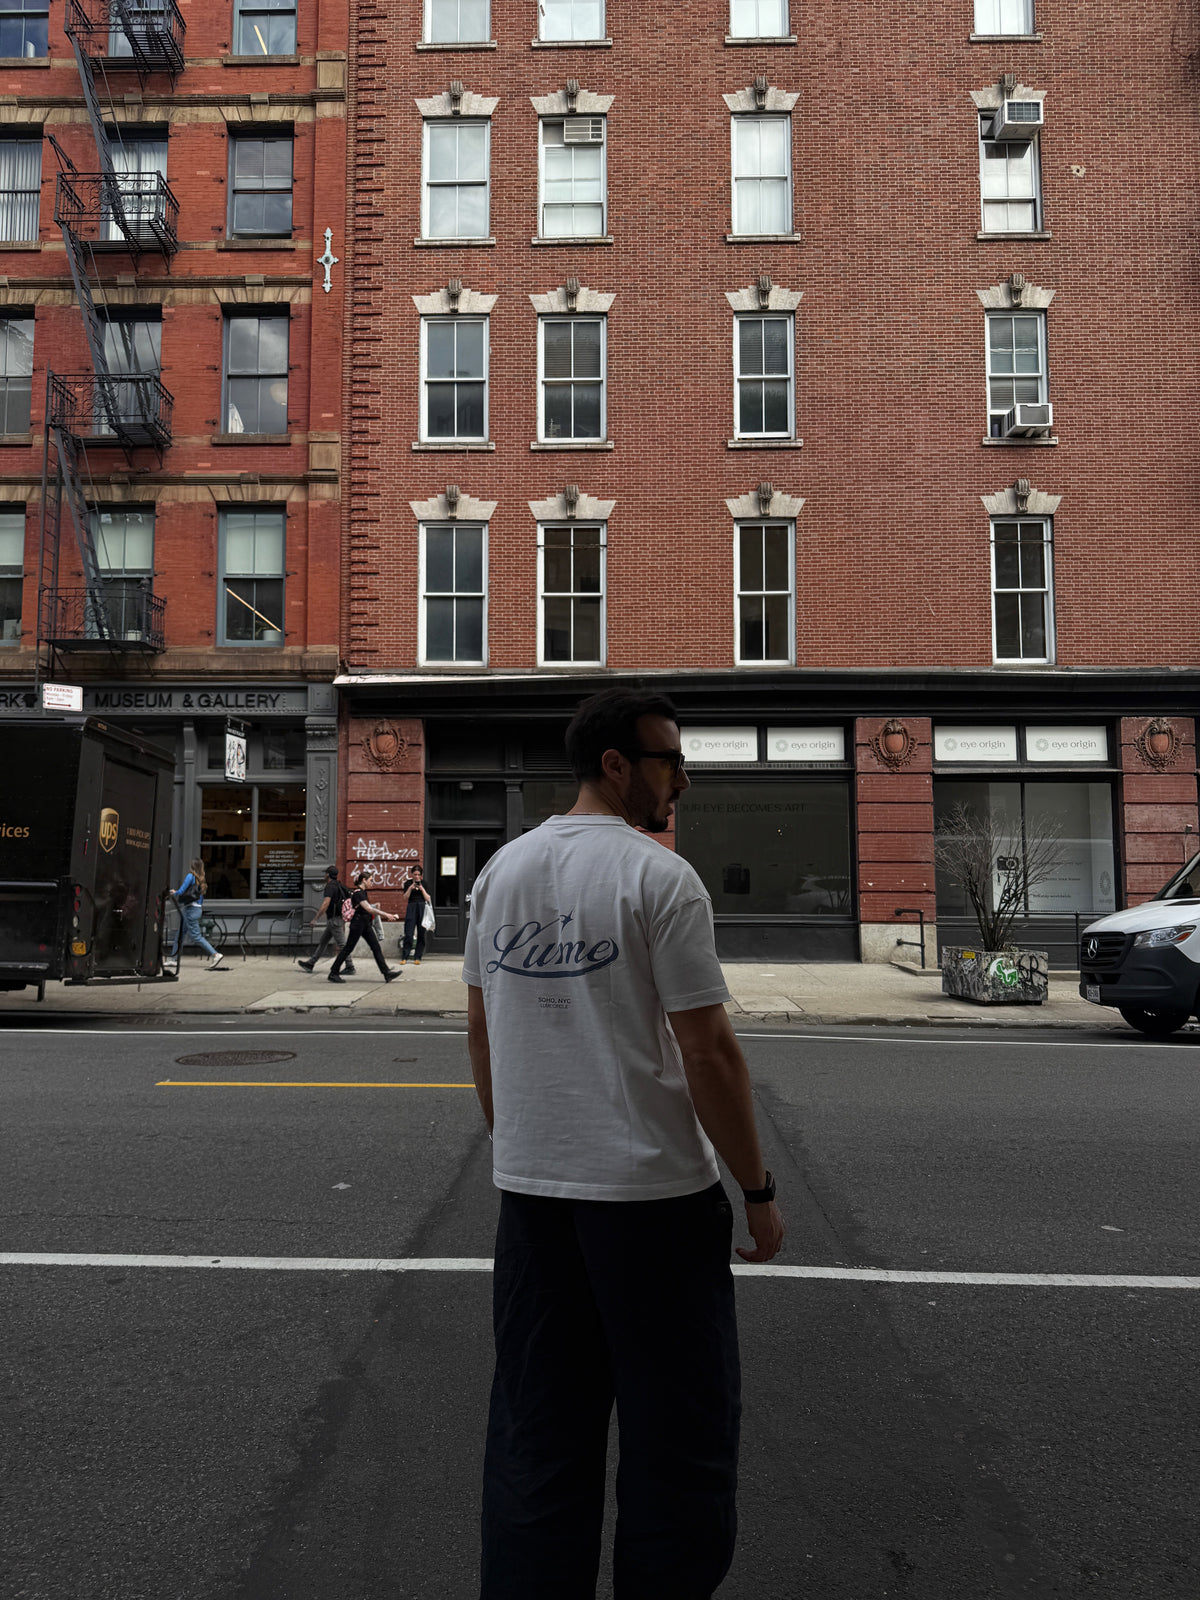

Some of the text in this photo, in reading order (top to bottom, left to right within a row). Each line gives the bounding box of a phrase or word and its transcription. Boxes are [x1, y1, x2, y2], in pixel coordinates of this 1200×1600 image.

[96, 693, 172, 708] MUSEUM
[182, 693, 194, 708] &
[198, 693, 281, 708] GALLERY
[704, 739, 749, 750] eye origin
[791, 740, 836, 751] eye origin
[960, 739, 1006, 749] eye origin
[1052, 739, 1097, 749] eye origin
[703, 803, 725, 813] EYE
[727, 803, 781, 813] BECOMES
[784, 803, 805, 813] ART
[0, 823, 30, 838] ices
[101, 821, 118, 846] ups
[486, 918, 619, 979] Lume
